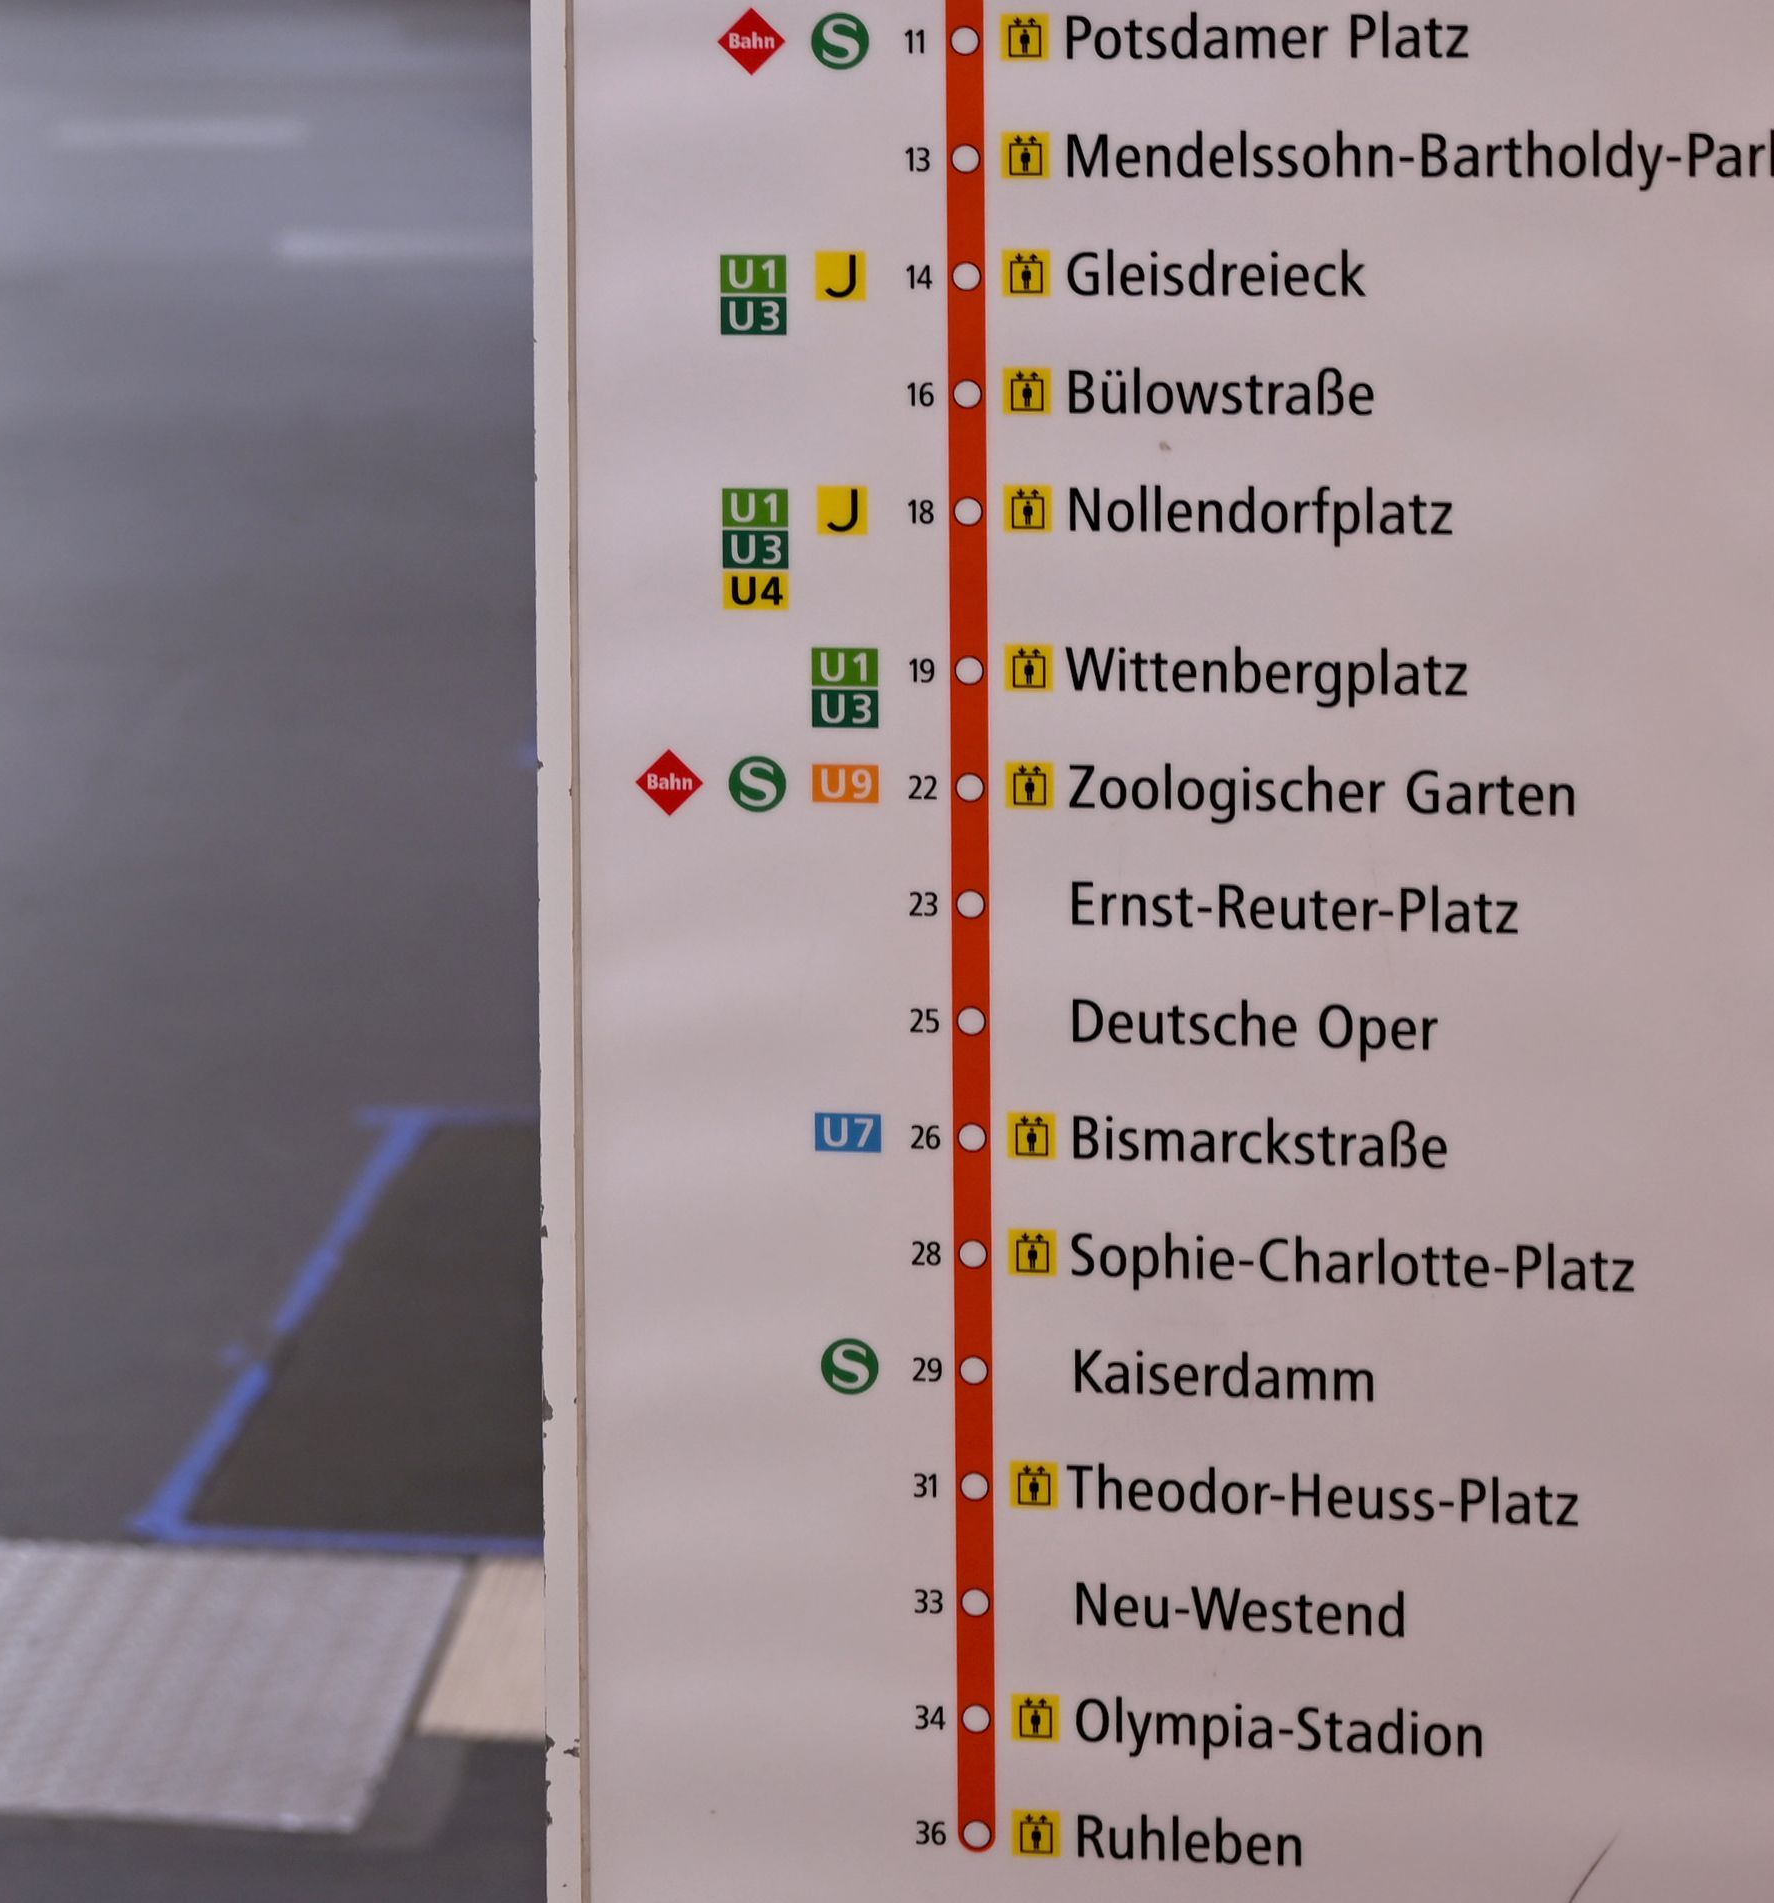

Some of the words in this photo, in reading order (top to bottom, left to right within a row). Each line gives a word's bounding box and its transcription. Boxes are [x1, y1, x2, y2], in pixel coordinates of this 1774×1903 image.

[728, 31, 775, 49] Bahn
[823, 18, 860, 63] S
[905, 30, 924, 53] 11
[1067, 12, 1328, 59] Potsdamer
[1351, 11, 1468, 58] Platz
[906, 147, 930, 172] 13
[1068, 129, 1774, 191] Mendelssohn-Bartholdy-Par
[729, 260, 775, 289] U1
[907, 265, 932, 289] 14
[1068, 249, 1365, 296] Gleisdreieck
[729, 301, 779, 330] U3
[908, 383, 934, 407] 16
[1069, 367, 1373, 415] Bülowstraße
[731, 493, 777, 522] U1
[908, 500, 934, 524] 18
[1070, 485, 1452, 547] Nollendorfplatz
[731, 535, 781, 564] U3
[732, 576, 783, 605] U4
[821, 652, 867, 682] U1
[910, 659, 934, 683] 19
[1066, 646, 1467, 708] Wittenbergplatz
[821, 694, 871, 723] U3
[646, 773, 693, 791] Bahn
[739, 761, 777, 807] S
[821, 768, 872, 799] U9
[909, 775, 937, 799] 22
[1069, 763, 1385, 824] Zoologischer
[1407, 770, 1574, 816] Garten
[910, 892, 937, 916] 23
[1072, 882, 1518, 934] Ernst-Reuter-Platz
[910, 1009, 939, 1033] 25
[1073, 999, 1297, 1047] Deutsche
[1319, 1004, 1438, 1062] Oper
[824, 1118, 873, 1147] U7
[911, 1125, 940, 1149] 26
[1073, 1116, 1447, 1169] Bismarckstraße
[912, 1241, 941, 1265] 28
[1072, 1232, 1634, 1292] Sophie-Charlotte-Platz
[833, 1345, 869, 1388] S
[913, 1358, 942, 1382] 29
[1075, 1349, 1373, 1402] Kaiserdamm
[914, 1474, 936, 1497] 31
[1067, 1463, 1578, 1526] Theodor-Heuss-Platz
[915, 1589, 943, 1614] 33
[1077, 1582, 1404, 1637] Neu-Westend
[916, 1705, 945, 1730] 34
[1076, 1696, 1482, 1759] Olympia-Stadion
[916, 1821, 946, 1845] 36
[1078, 1814, 1301, 1866] Ruhleben
